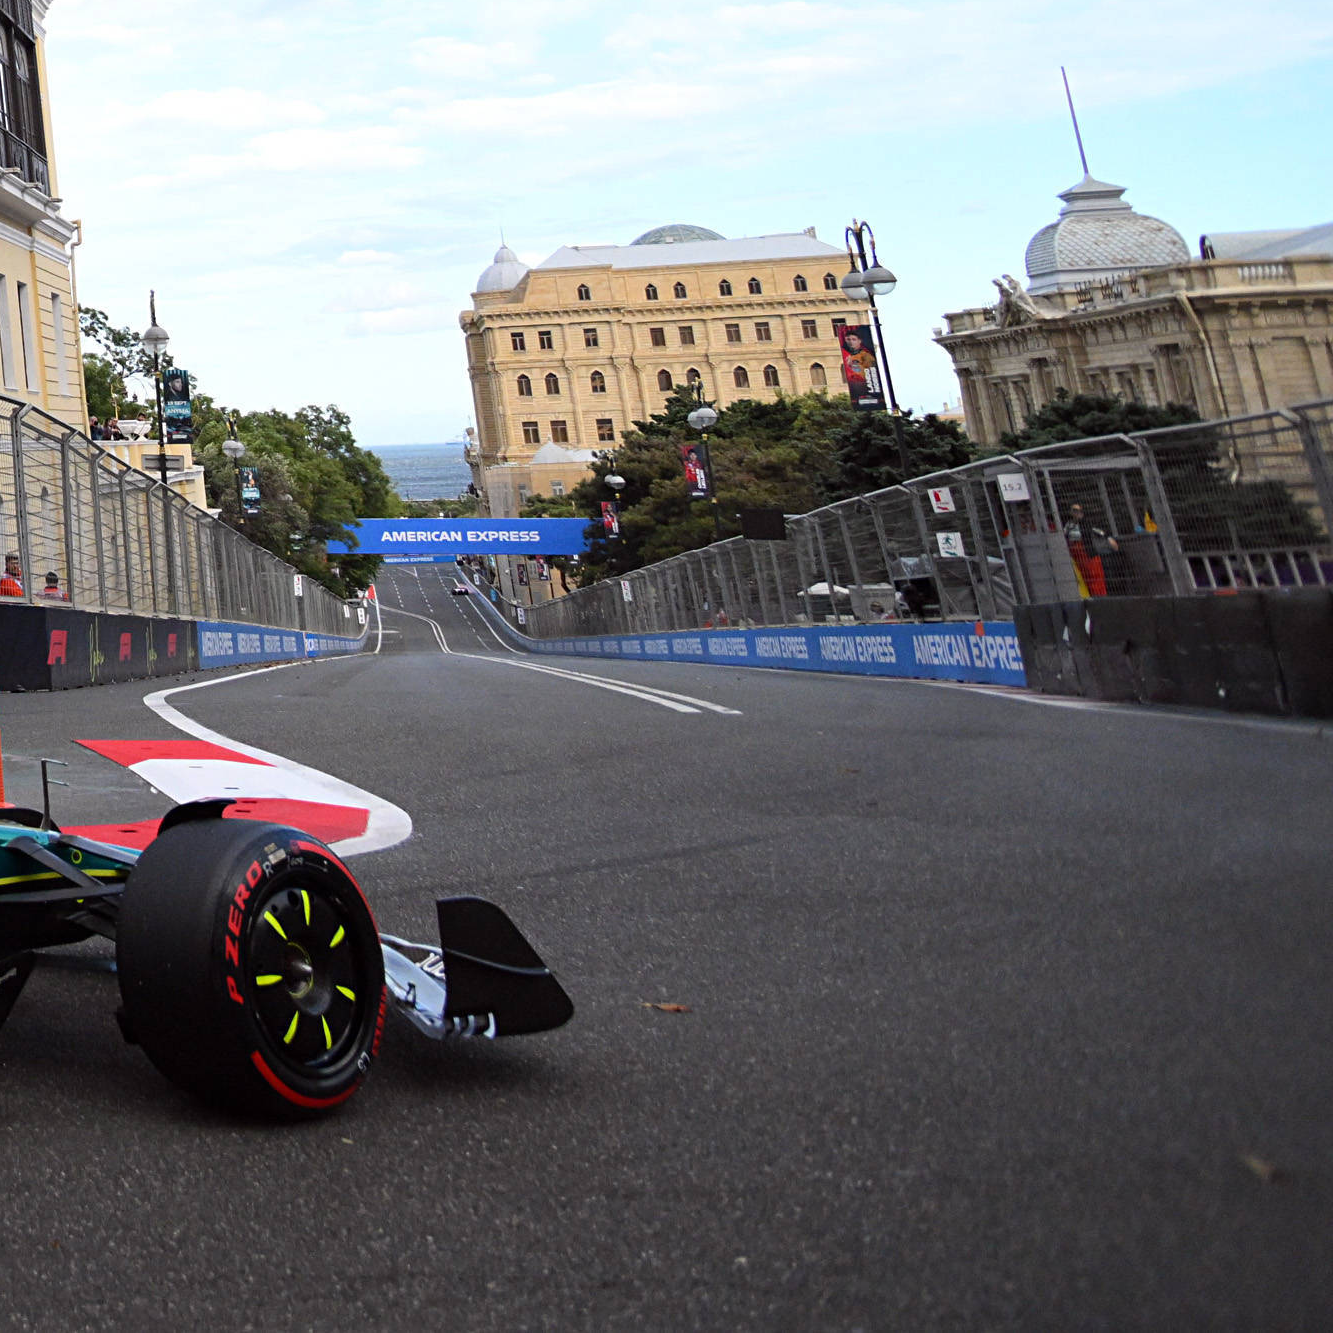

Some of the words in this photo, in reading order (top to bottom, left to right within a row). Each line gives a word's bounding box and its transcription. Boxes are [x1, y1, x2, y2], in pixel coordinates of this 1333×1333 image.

[1004, 483, 1023, 491] 15.2
[381, 531, 463, 542] AMERICAN
[466, 530, 541, 542] EXPRESS
[755, 636, 782, 657] AMERICAN
[779, 636, 809, 659] EXPRESS
[819, 636, 856, 661] AMERICAN
[855, 636, 896, 664] EXPRESS
[912, 635, 970, 666] AMERICAN
[225, 860, 263, 967] ZERO
[226, 975, 245, 1005] P
